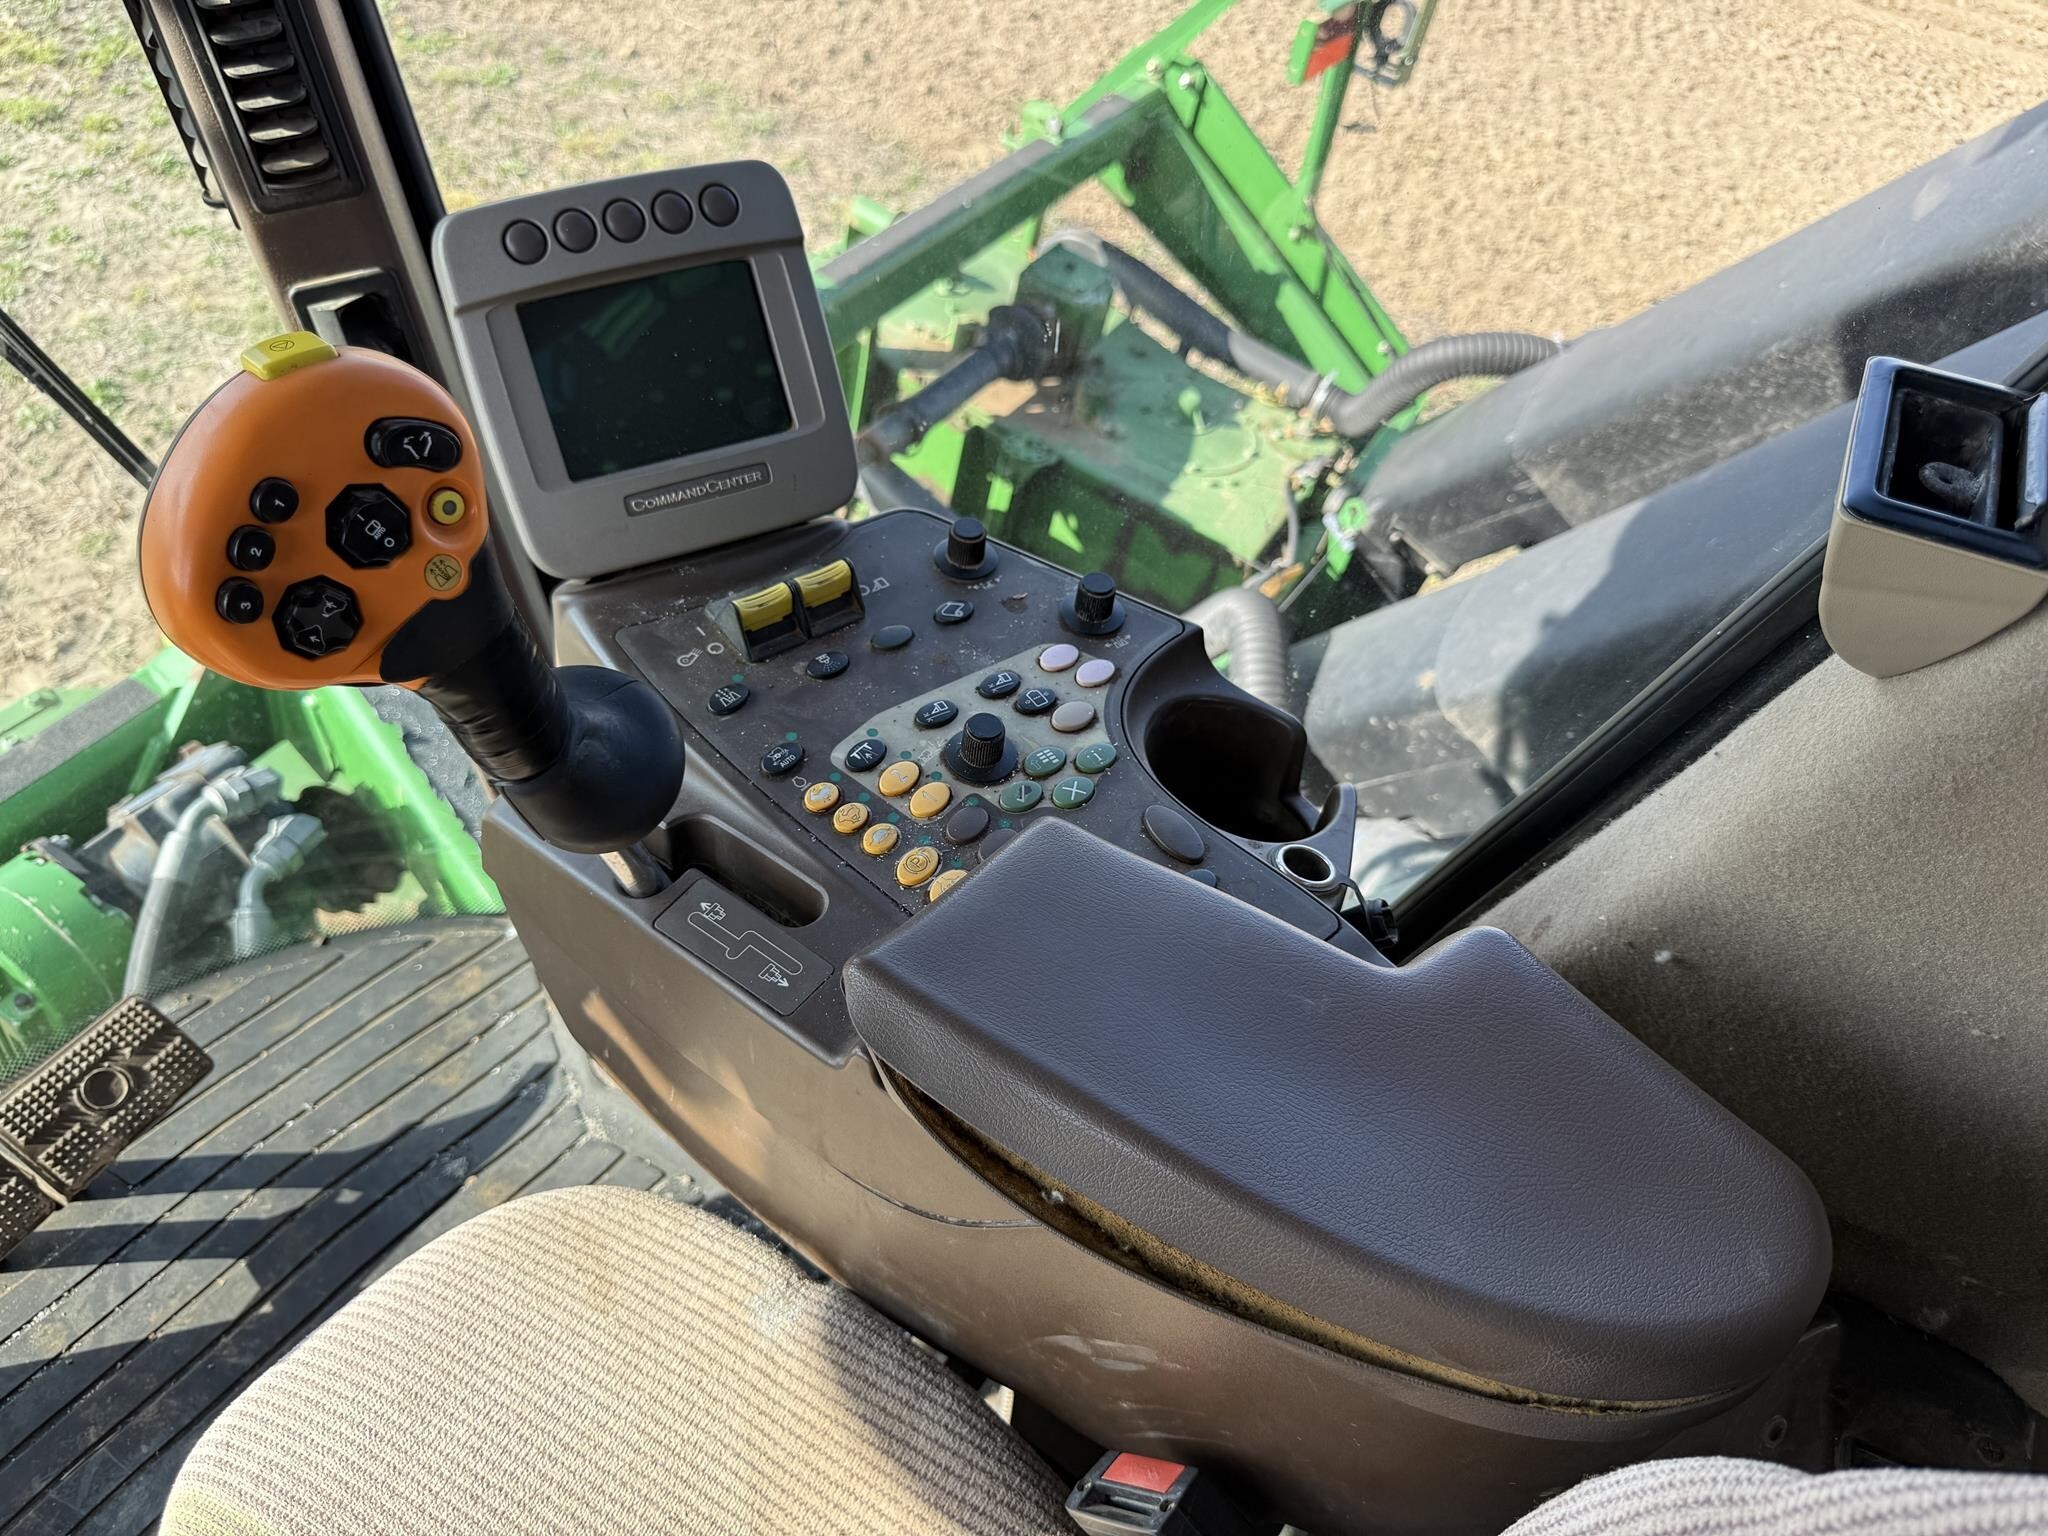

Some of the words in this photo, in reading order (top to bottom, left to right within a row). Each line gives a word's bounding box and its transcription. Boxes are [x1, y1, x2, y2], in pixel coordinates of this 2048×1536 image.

[274, 499, 285, 508] 1
[250, 547, 262, 557] 2
[240, 601, 252, 611] 3
[780, 754, 797, 768] AUTO
